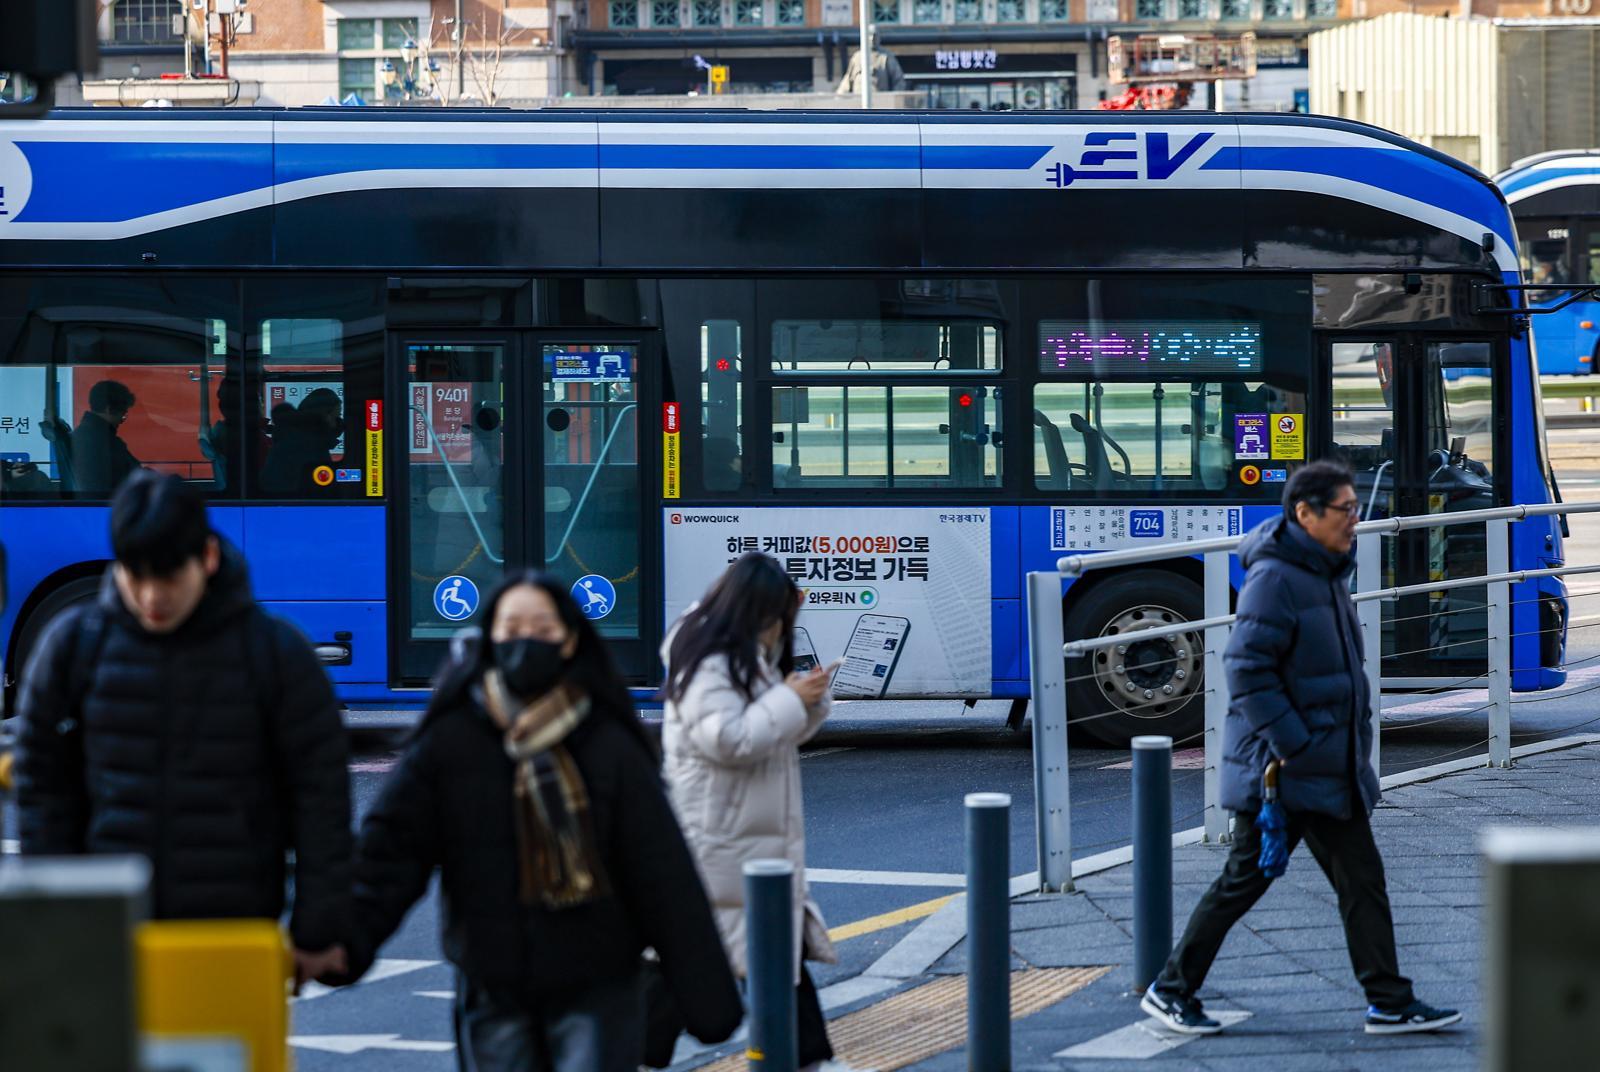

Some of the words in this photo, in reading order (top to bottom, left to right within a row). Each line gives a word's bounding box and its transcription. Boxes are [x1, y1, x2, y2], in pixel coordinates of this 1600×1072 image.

[1080, 132, 1215, 180] EV
[436, 388, 468, 402] 9401
[684, 515, 740, 523] WOWQUICK
[939, 514, 986, 523] 한국경제TV
[1134, 517, 1160, 531] 704
[763, 536, 930, 555] 커피값(5,000원)으로
[785, 557, 877, 582] 투자정보
[882, 557, 929, 582] 가득
